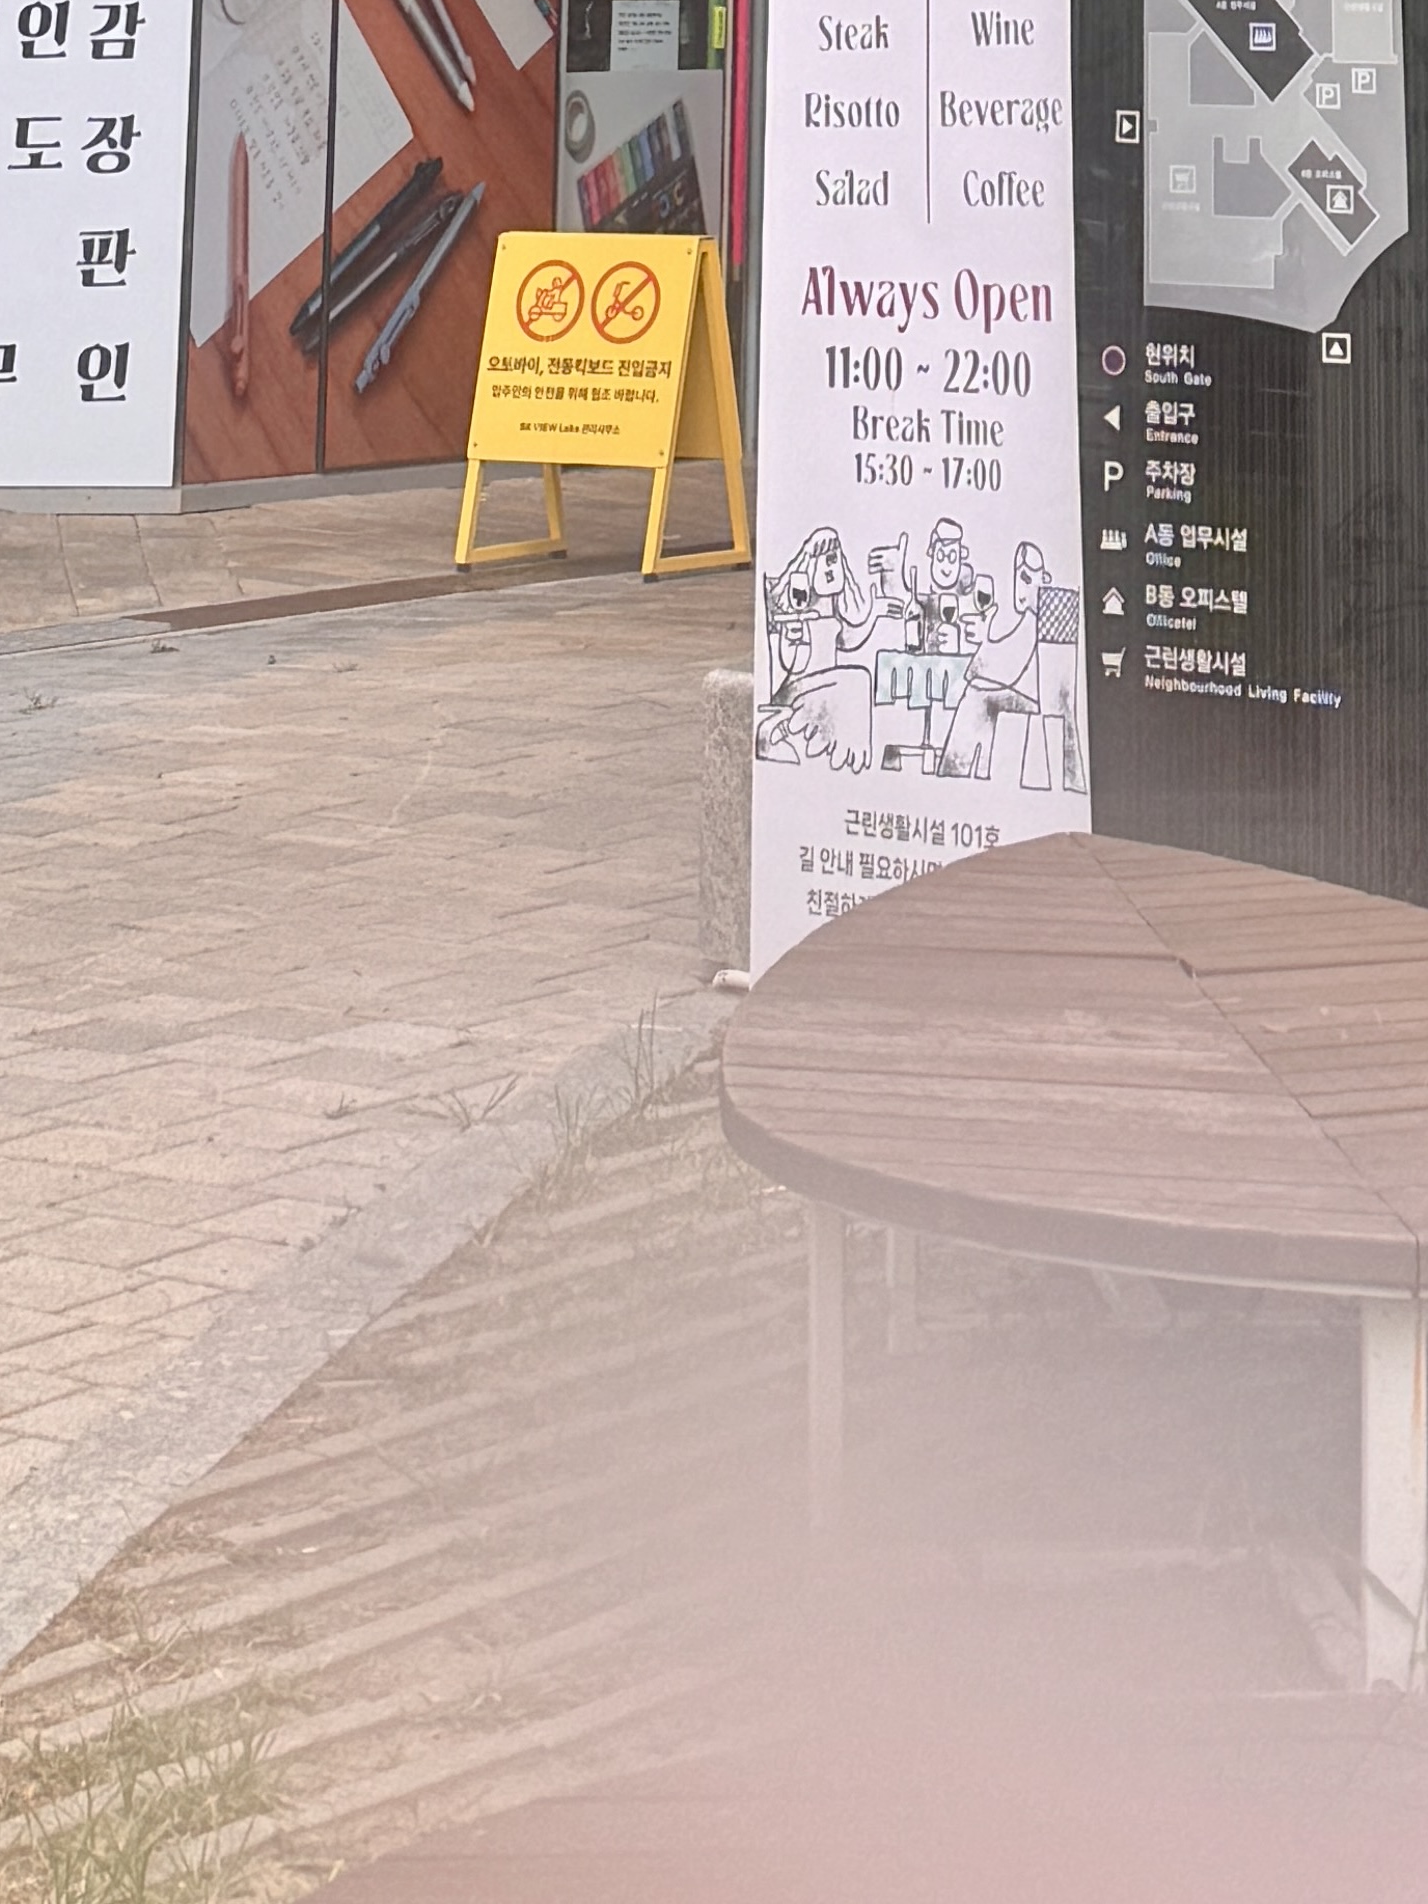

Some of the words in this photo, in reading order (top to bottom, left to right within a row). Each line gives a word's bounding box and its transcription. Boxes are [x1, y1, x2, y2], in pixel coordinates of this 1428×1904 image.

[818, 15, 890, 51] Steak
[971, 11, 1034, 47] Wine
[805, 92, 900, 128] Risotto
[940, 91, 1063, 133] Beverage
[816, 169, 890, 207] Salad
[963, 170, 1045, 207] Coffee
[802, 265, 939, 334] Always
[954, 269, 1052, 334] Open
[1145, 343, 1195, 369] 현위치
[825, 346, 903, 391] 11:00
[943, 349, 1031, 397] 22:00
[1145, 370, 1178, 385] South
[1184, 372, 1212, 387] Gate
[852, 405, 930, 443] Break
[941, 409, 1004, 447] Time
[1145, 400, 1195, 426] 출입구
[1146, 428, 1199, 445] Entrance
[854, 453, 913, 487] 15:30
[941, 457, 1002, 491] 17:00
[1145, 460, 1196, 486] 주차장
[1146, 486, 1191, 503] Parking
[1144, 524, 1174, 547] A동
[1180, 526, 1247, 552] 업무시설
[1146, 585, 1174, 608] B동
[1179, 588, 1247, 614] 오피스텔
[1144, 646, 1246, 676] 근린생활시설
[1248, 684, 1287, 703] Living
[845, 809, 945, 846] 근린생활시설
[951, 823, 1000, 848] 101호
[800, 846, 814, 872] 길
[820, 848, 853, 876] 안내
[807, 889, 872, 917] 친절하
